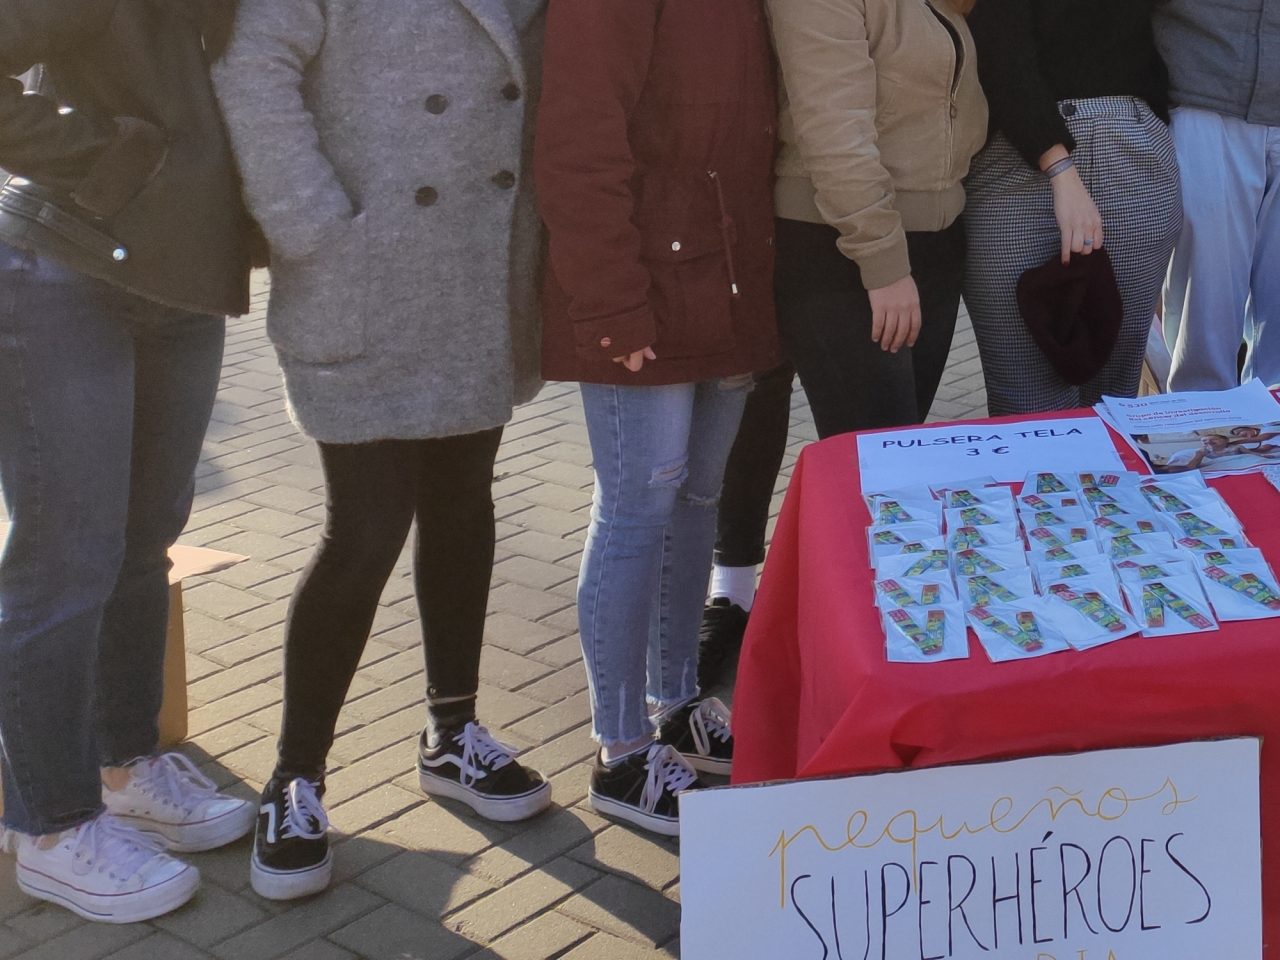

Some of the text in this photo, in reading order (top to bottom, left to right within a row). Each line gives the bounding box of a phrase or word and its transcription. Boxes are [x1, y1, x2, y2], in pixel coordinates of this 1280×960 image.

[882, 428, 1083, 449] PULSERA TELA
[966, 446, 1010, 456] 3 €
[768, 776, 1199, 909] pequeños
[790, 830, 1212, 960] SUPERHÉROES
